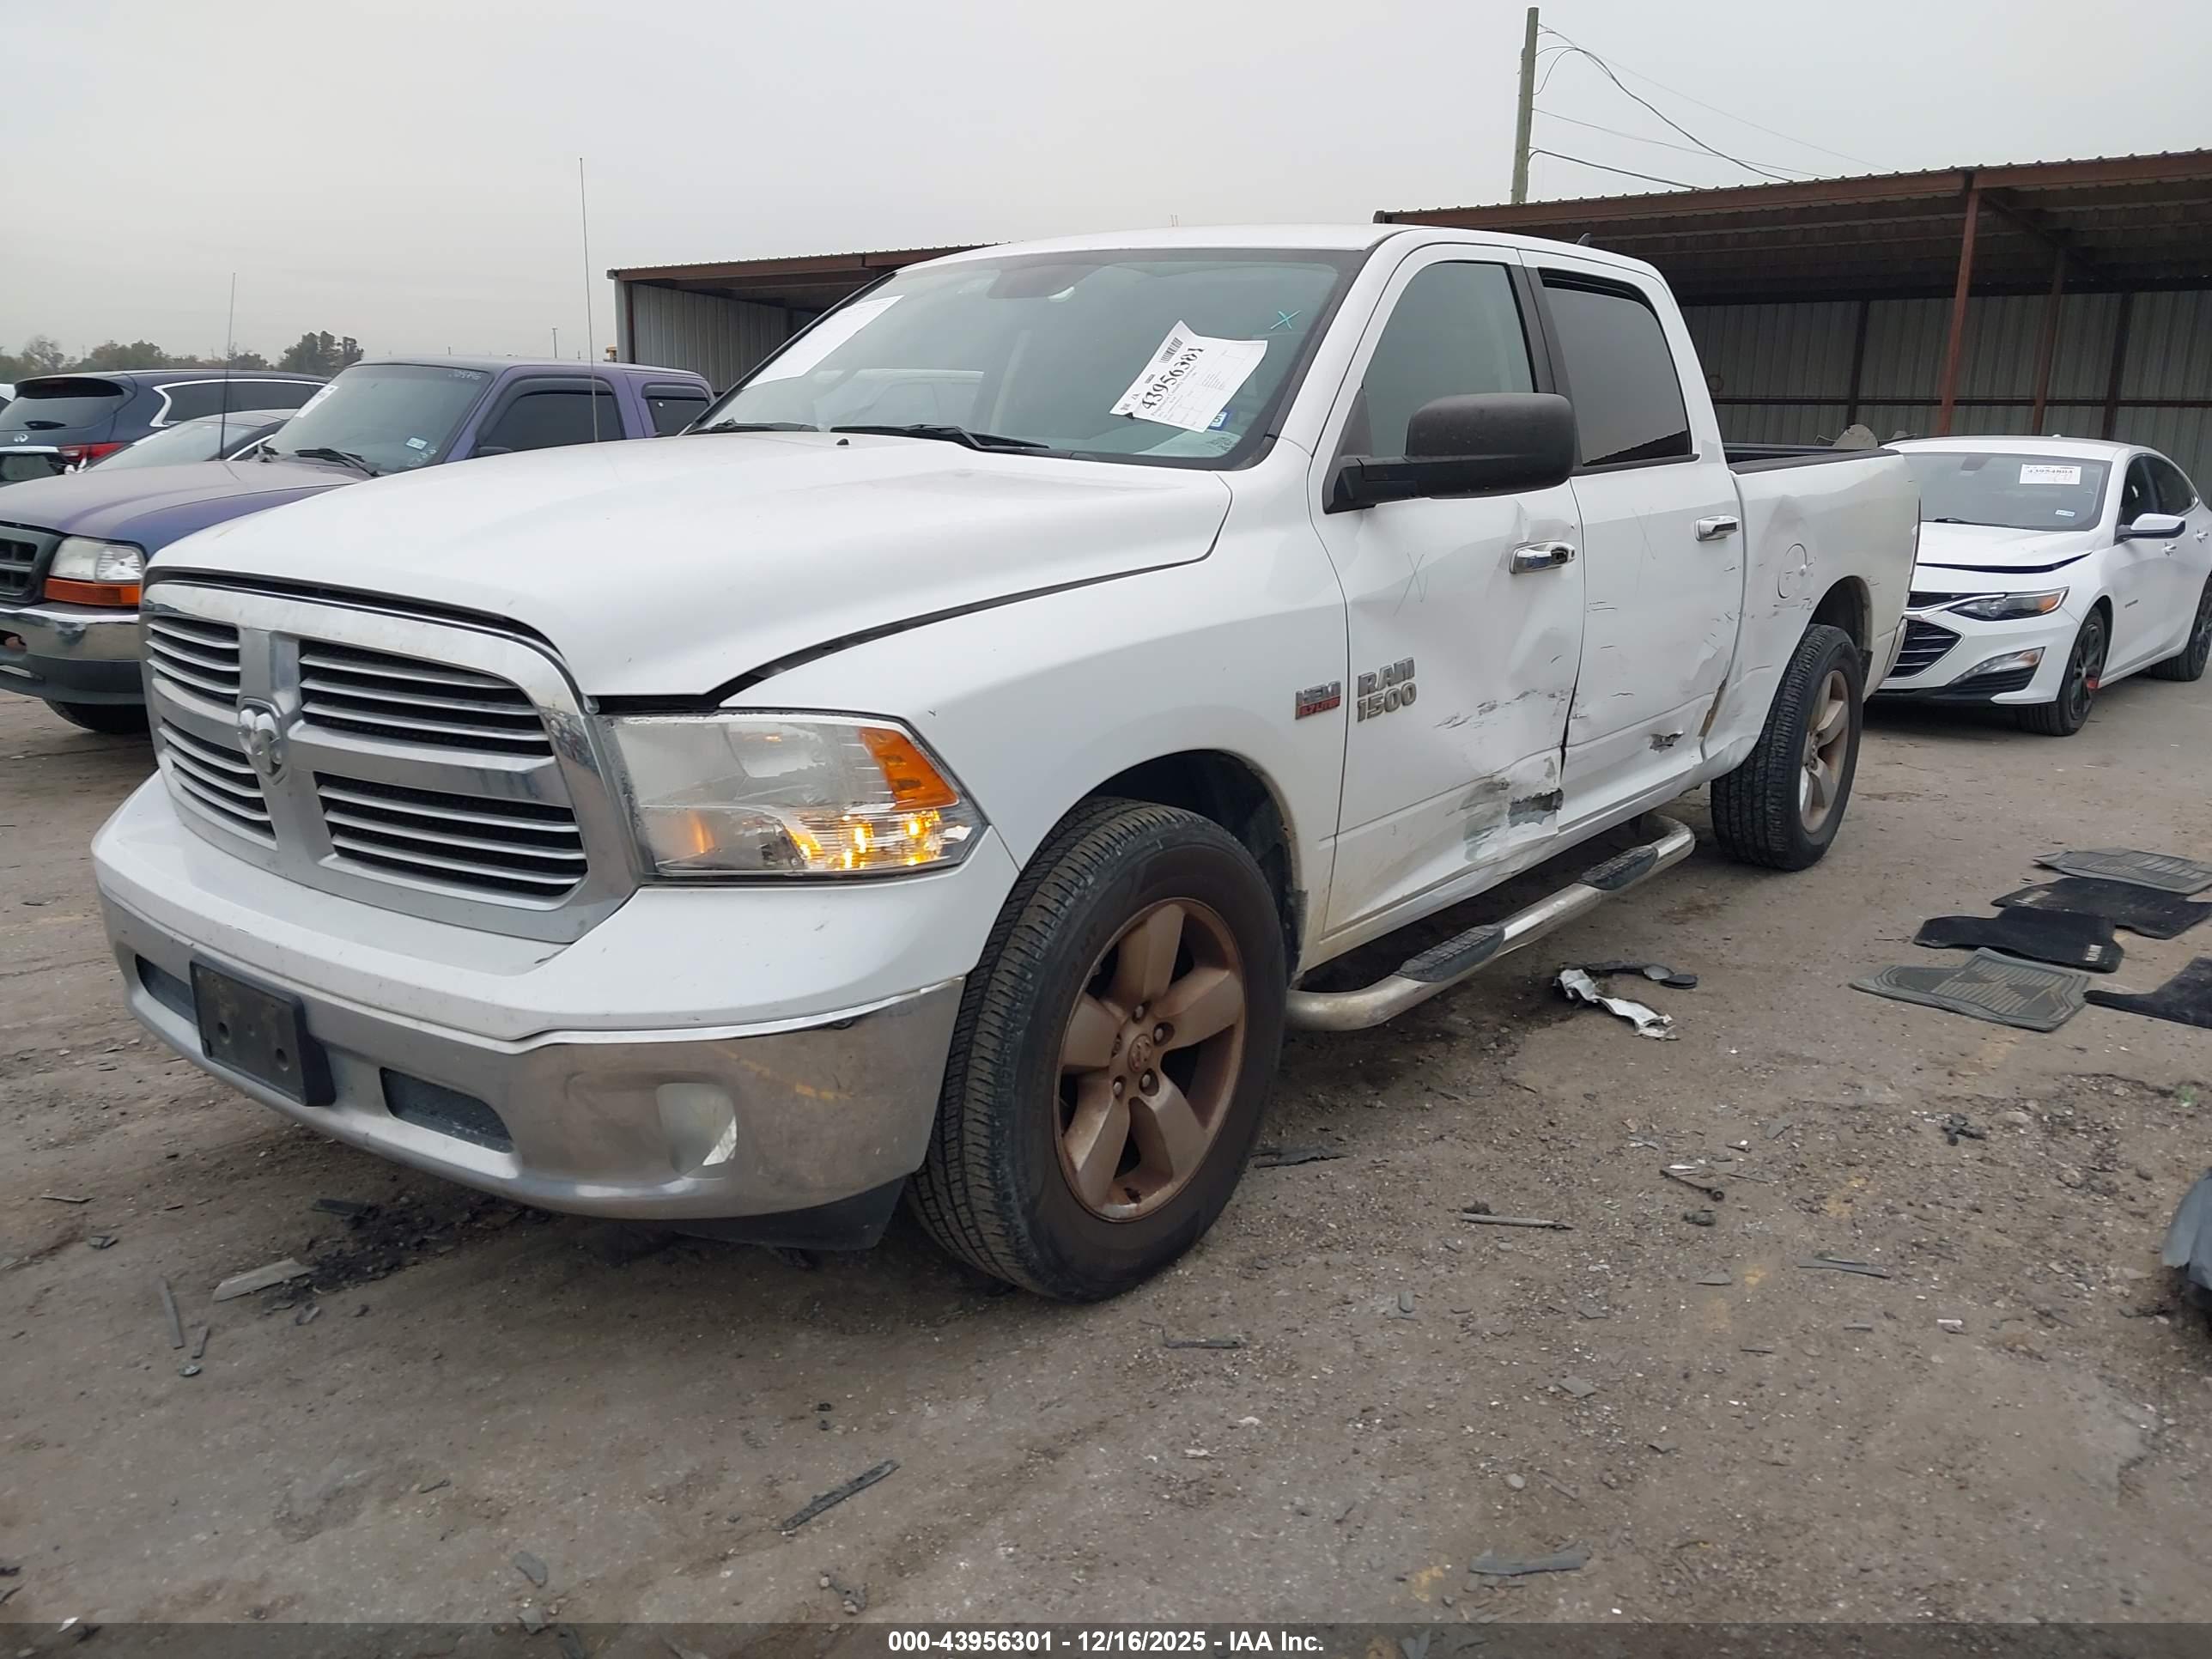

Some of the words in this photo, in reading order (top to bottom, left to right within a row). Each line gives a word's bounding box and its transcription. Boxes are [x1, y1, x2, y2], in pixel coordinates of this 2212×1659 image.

[1142, 348, 1205, 410] 43956301
[1357, 656, 1416, 698] RAM
[1356, 681, 1417, 723] 1500
